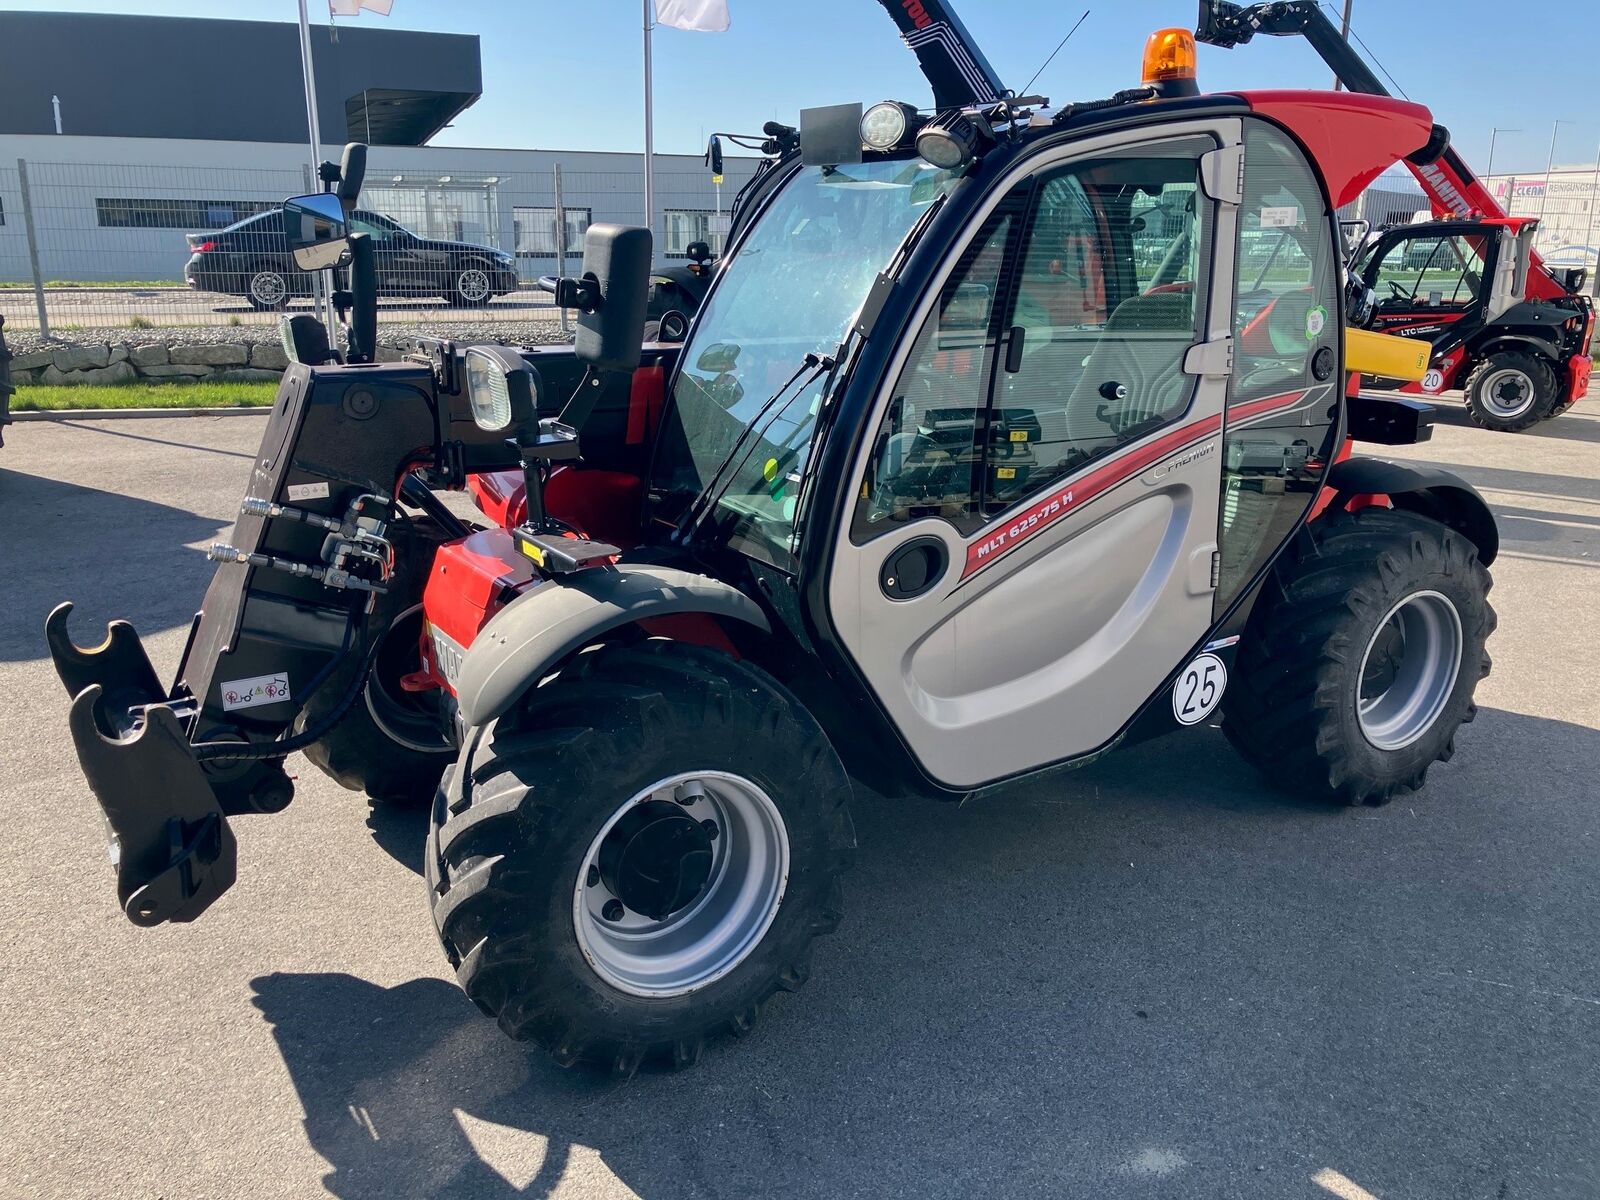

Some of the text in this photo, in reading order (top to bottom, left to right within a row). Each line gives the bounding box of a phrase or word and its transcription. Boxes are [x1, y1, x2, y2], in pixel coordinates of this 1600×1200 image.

[1416, 164, 1470, 217] MANITO
[1401, 328, 1417, 336] LTC
[1424, 373, 1439, 387] 20
[977, 491, 1073, 558] MLT 625-75 H
[1182, 665, 1217, 715] 25
